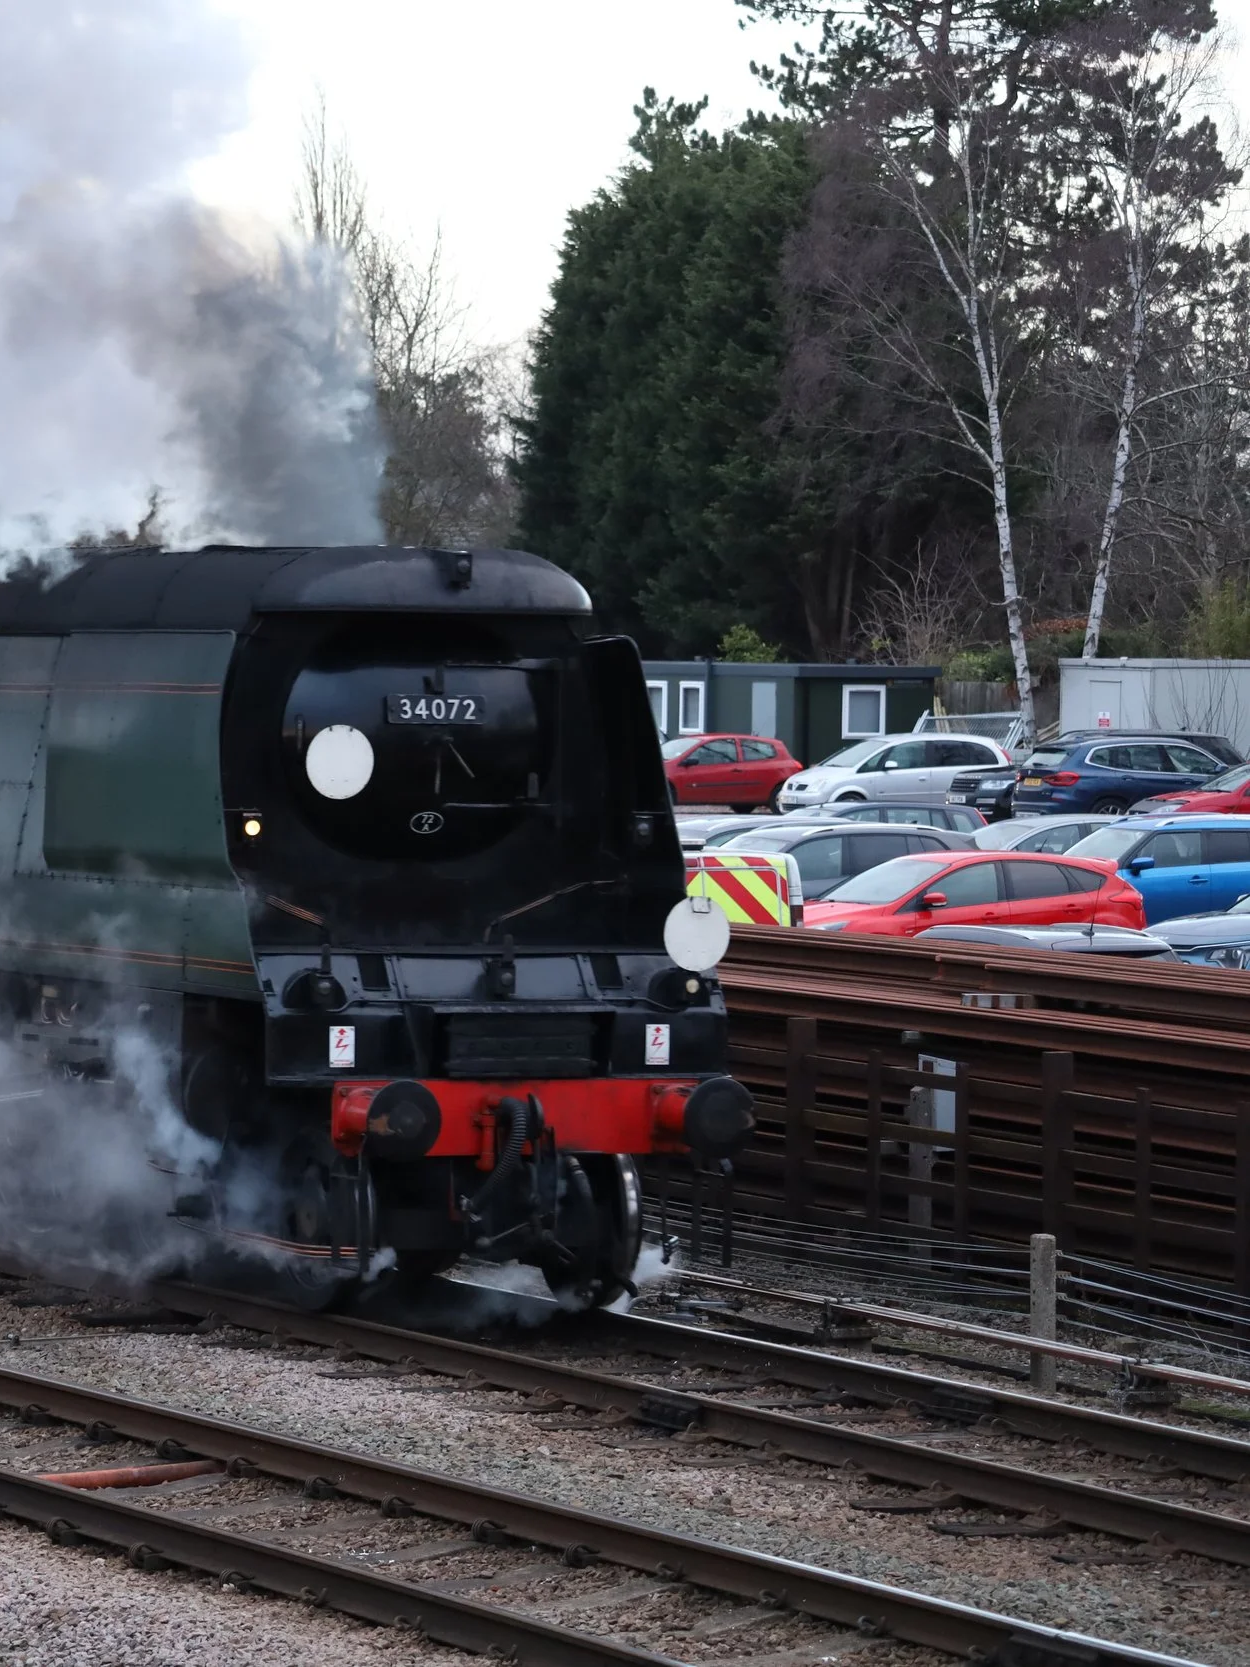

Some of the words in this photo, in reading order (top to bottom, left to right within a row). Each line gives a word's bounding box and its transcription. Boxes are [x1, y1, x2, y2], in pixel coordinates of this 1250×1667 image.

[399, 698, 476, 720] 34072
[421, 814, 435, 824] 72
[421, 823, 430, 832] A
